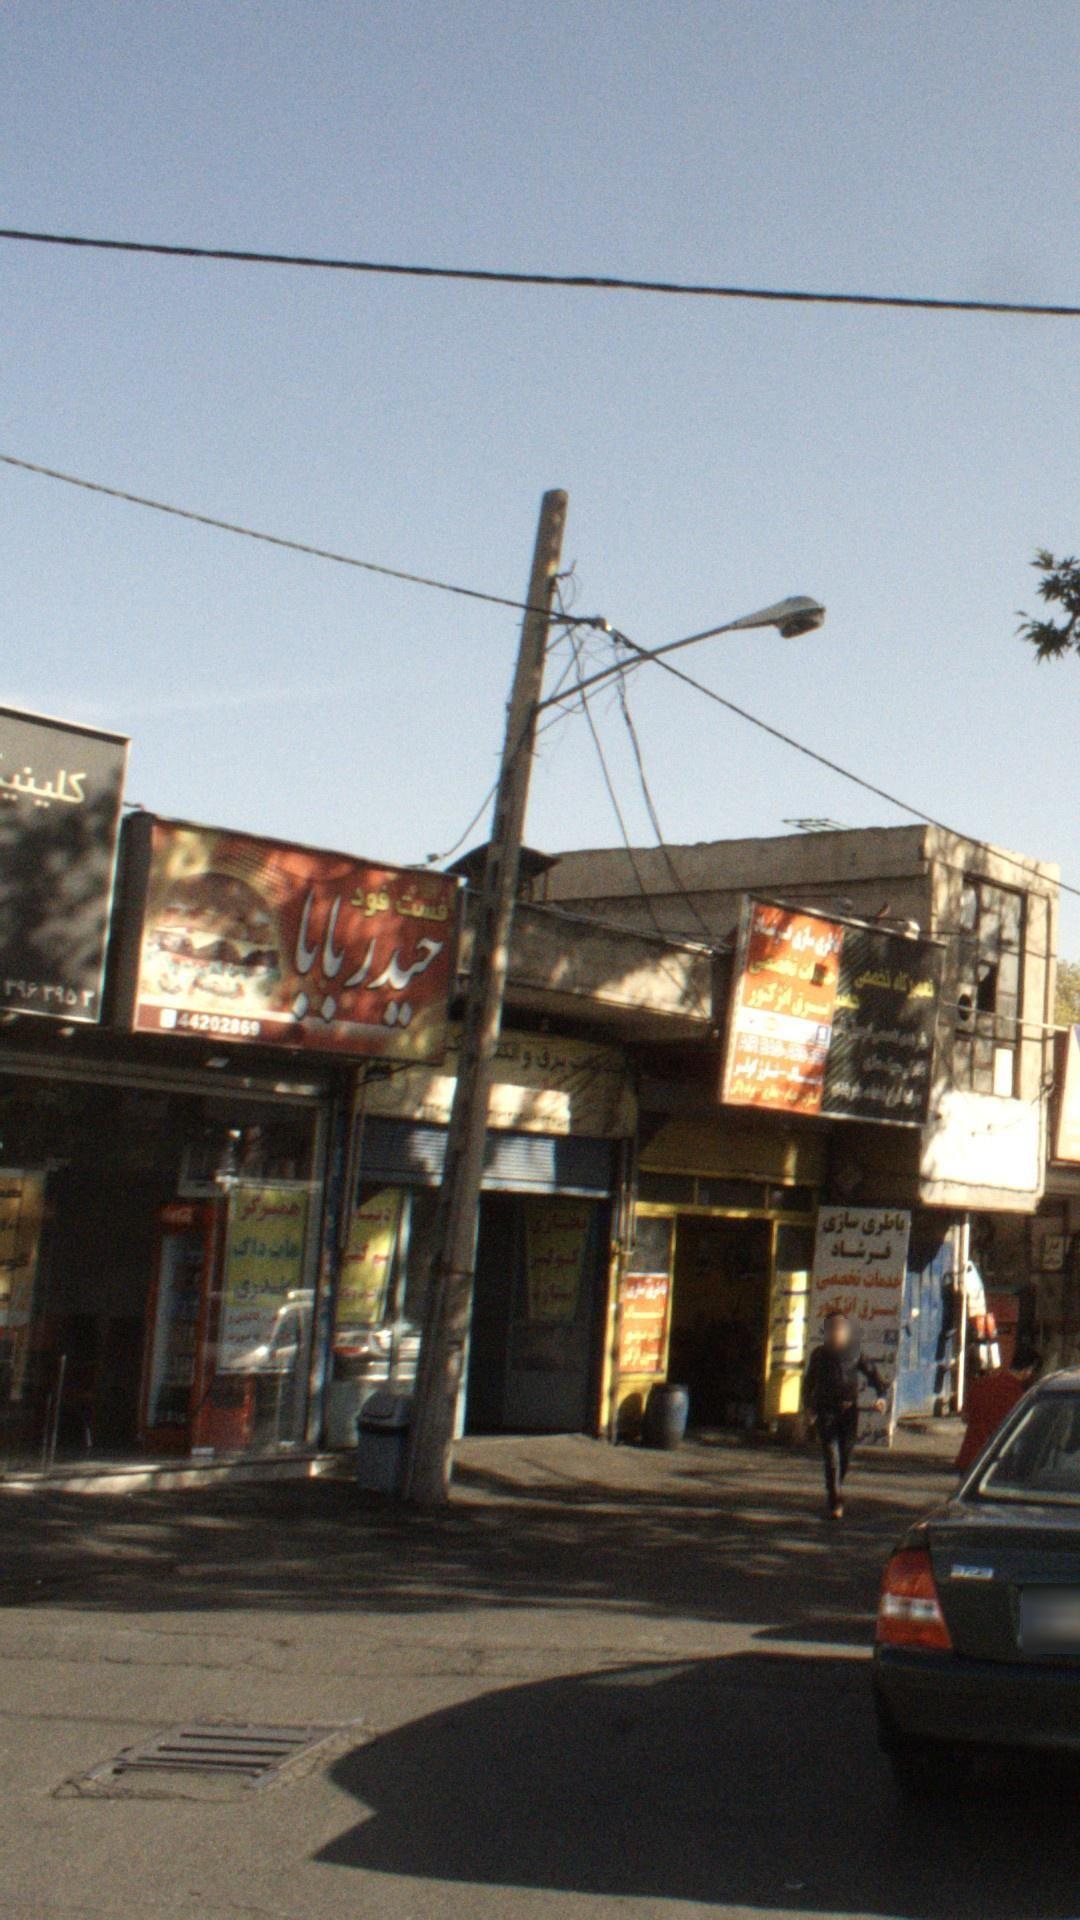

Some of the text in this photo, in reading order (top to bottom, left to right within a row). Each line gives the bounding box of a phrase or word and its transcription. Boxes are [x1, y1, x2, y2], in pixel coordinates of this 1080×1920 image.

[0, 766, 88, 807] کلینی
[351, 885, 451, 923] فست فود
[823, 1211, 905, 1236] باطری سازی
[830, 1239, 892, 1266] فرشاد
[815, 1269, 862, 1292] تخصصی
[857, 1298, 900, 1323] برق
